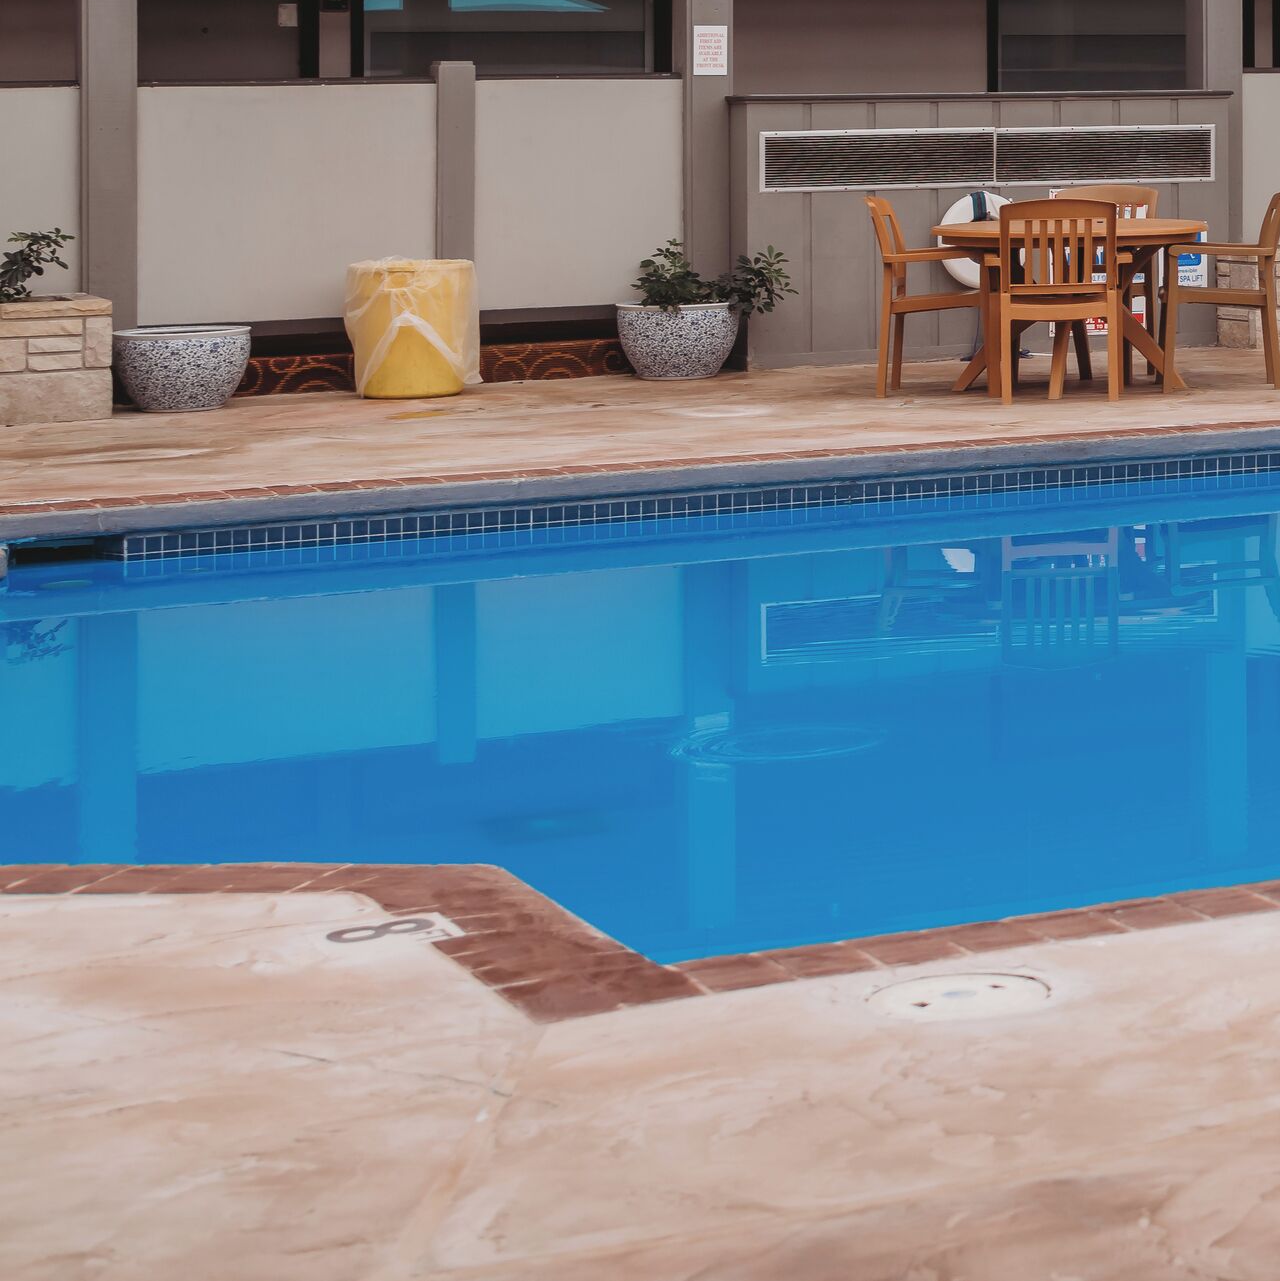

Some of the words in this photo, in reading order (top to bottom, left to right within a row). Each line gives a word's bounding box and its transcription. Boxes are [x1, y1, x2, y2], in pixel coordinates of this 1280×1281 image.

[1180, 275, 1191, 283] SPA
[1192, 274, 1203, 282] LIFT
[326, 918, 436, 943] 8
